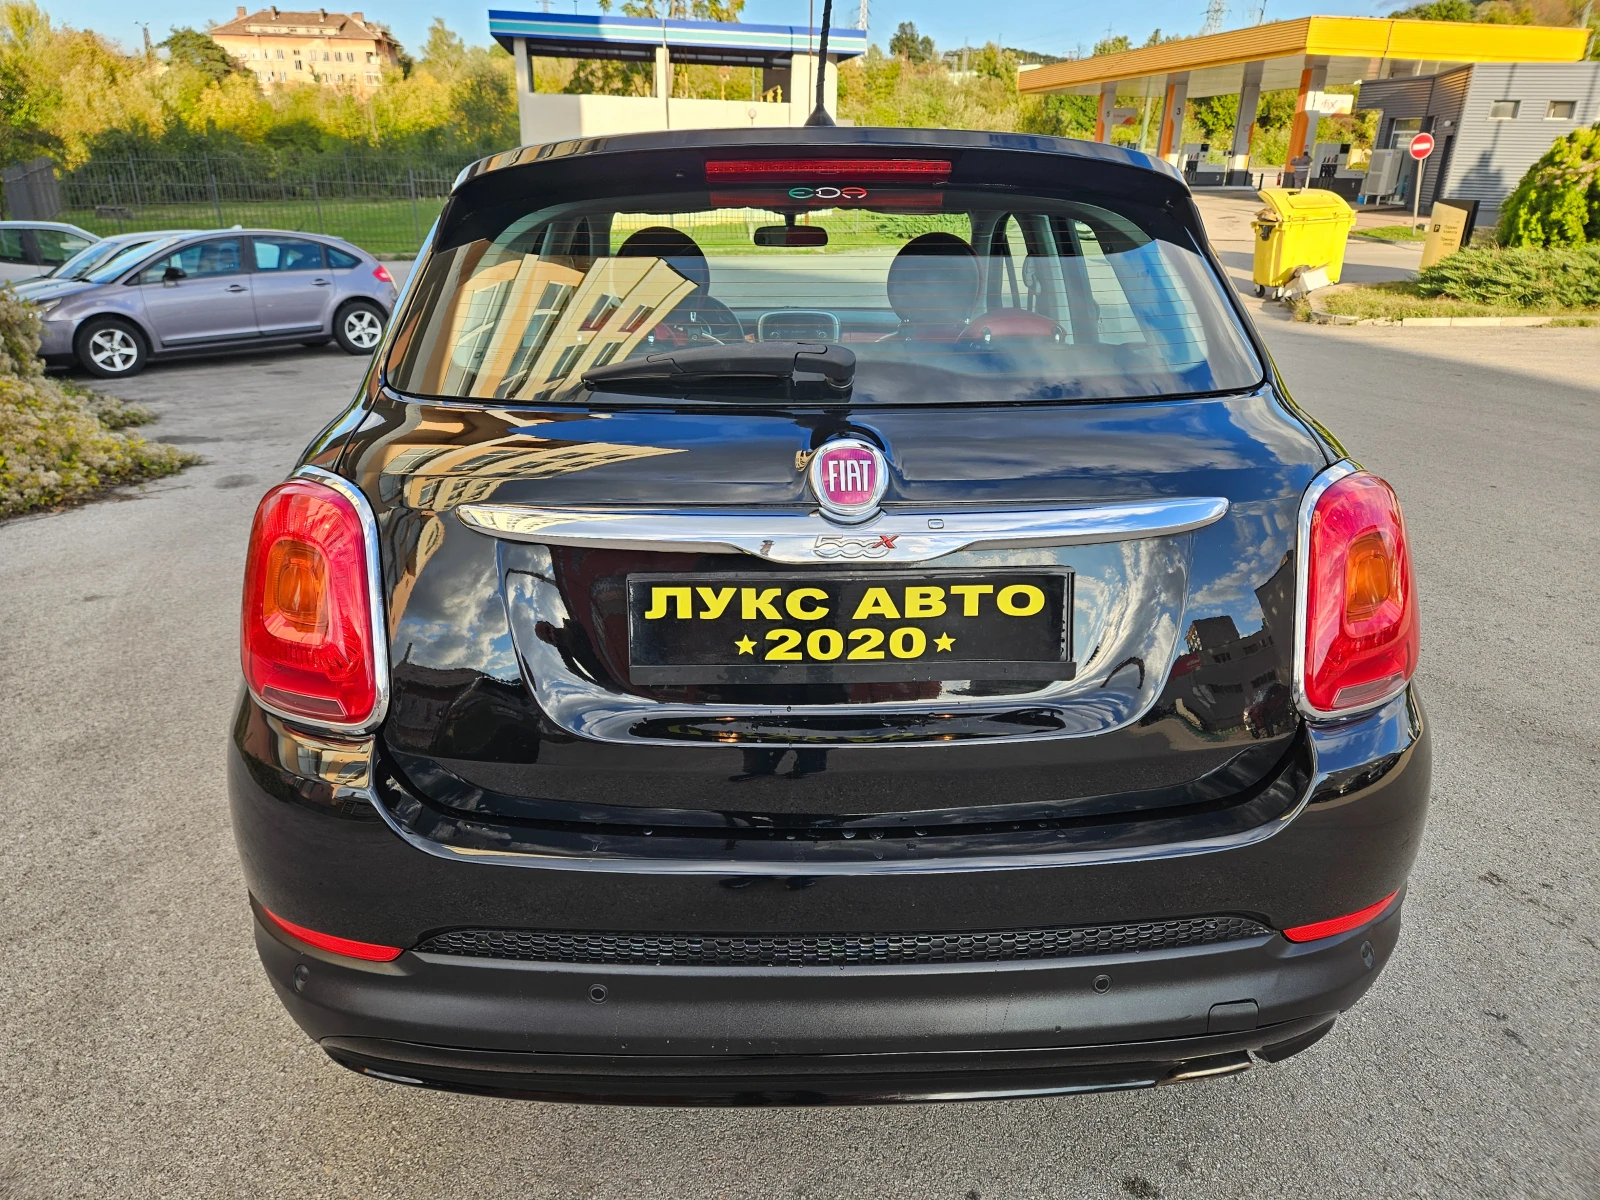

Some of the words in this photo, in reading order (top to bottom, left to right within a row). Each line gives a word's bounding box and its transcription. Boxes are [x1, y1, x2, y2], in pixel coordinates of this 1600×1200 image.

[1176, 107, 1181, 115] 3
[827, 459, 872, 493] FIAT
[645, 586, 829, 621] ЛУКС
[852, 584, 1046, 620] АВТО
[765, 626, 927, 661] 2020
